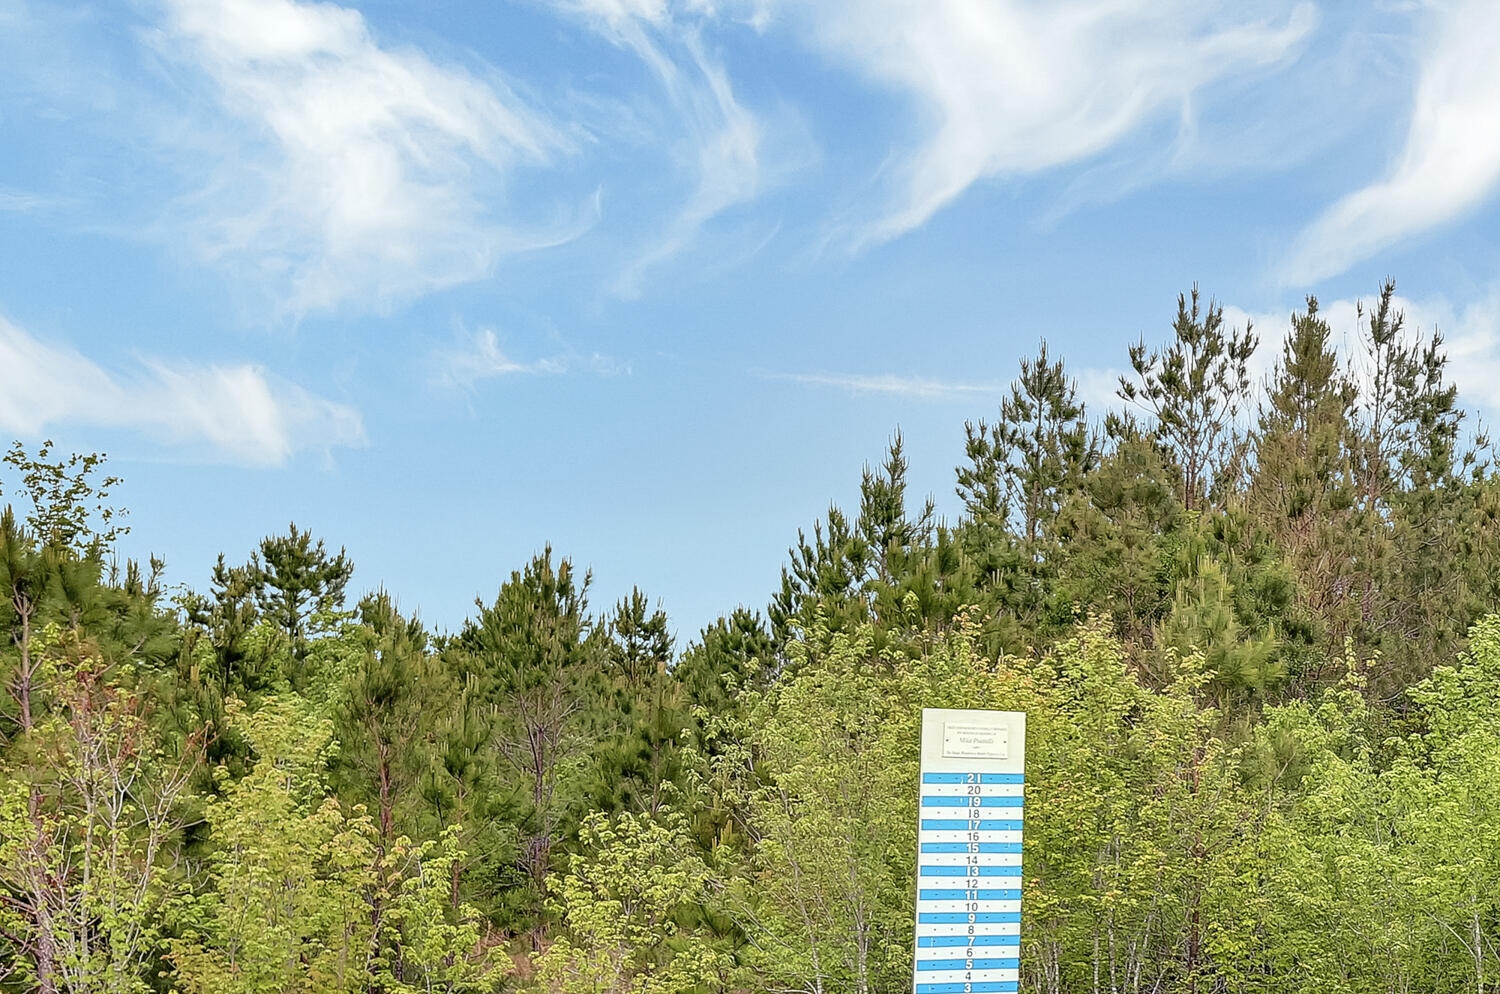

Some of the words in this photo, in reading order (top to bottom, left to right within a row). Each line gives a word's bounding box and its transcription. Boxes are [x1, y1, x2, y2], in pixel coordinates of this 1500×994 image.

[968, 774, 980, 783] 21
[968, 786, 980, 794] 20
[969, 797, 980, 806] 19
[969, 809, 980, 818] 18
[968, 821, 980, 830] 17
[968, 832, 979, 841] 16
[967, 844, 979, 852] 15
[967, 867, 979, 876] 13
[967, 879, 978, 888] 12
[966, 891, 977, 900] 11
[966, 903, 978, 911] 10
[968, 914, 975, 923] 9
[968, 926, 974, 934] 8
[968, 937, 975, 946] 7
[967, 948, 972, 957] 6
[966, 960, 973, 968] 5
[964, 984, 971, 992] 3
